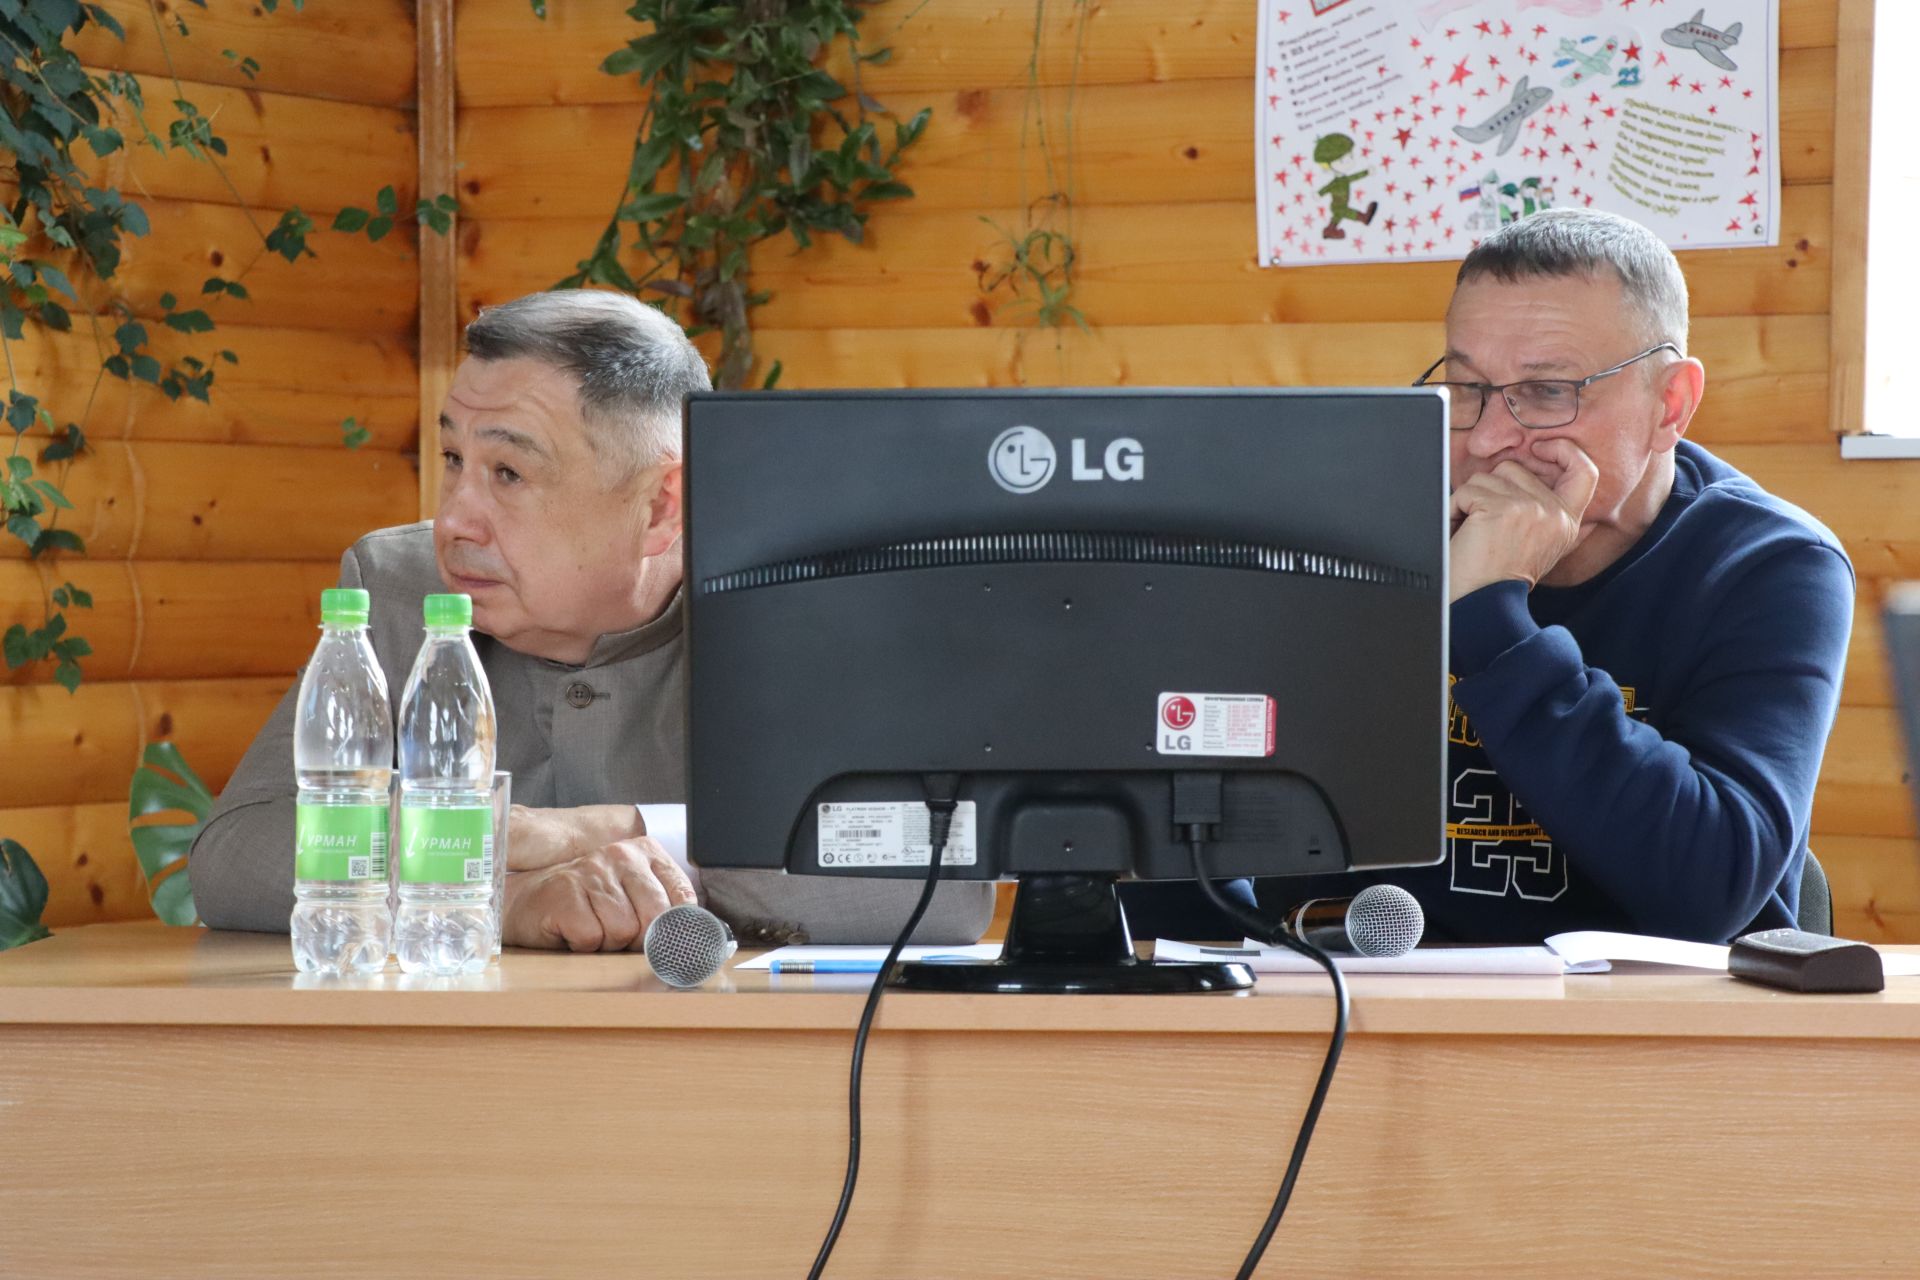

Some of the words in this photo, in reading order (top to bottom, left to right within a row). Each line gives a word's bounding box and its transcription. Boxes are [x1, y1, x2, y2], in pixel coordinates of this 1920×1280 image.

[1071, 437, 1145, 482] LG
[1164, 734, 1192, 751] LG
[1456, 827, 1487, 836] RESEARCH
[1488, 828, 1500, 837] AND
[307, 834, 358, 848] УРМАН
[422, 837, 472, 850] УРМАН
